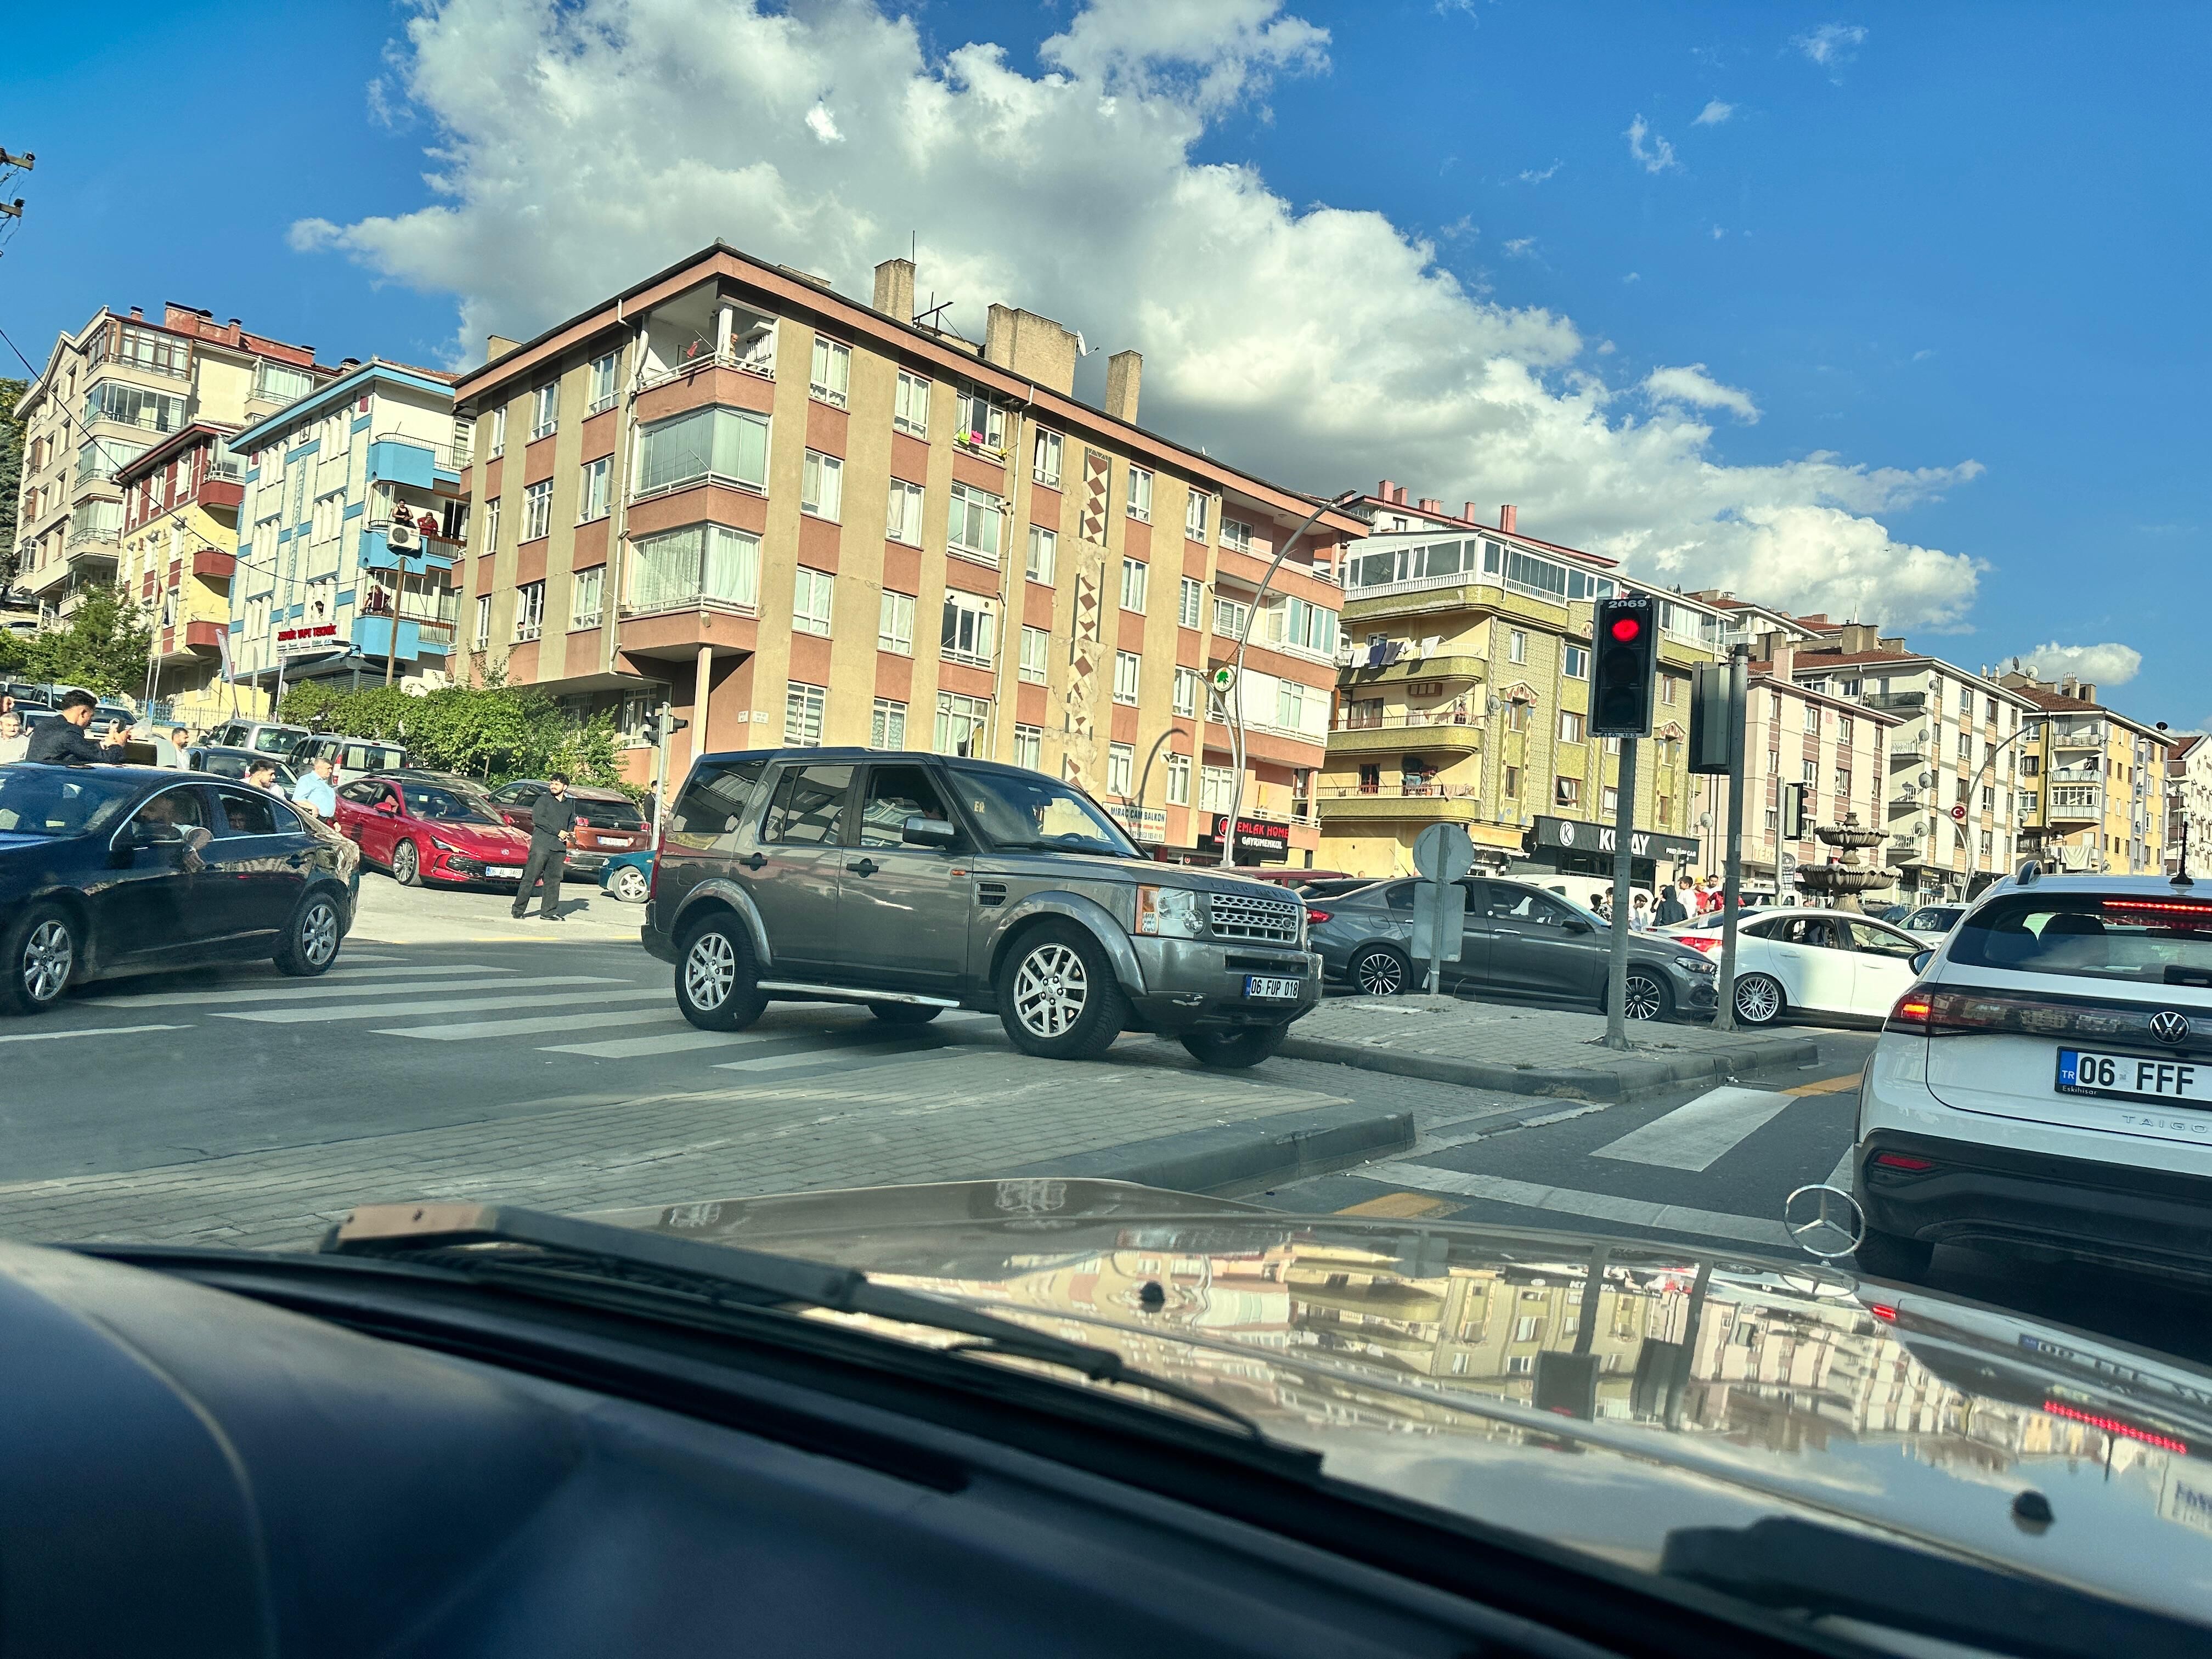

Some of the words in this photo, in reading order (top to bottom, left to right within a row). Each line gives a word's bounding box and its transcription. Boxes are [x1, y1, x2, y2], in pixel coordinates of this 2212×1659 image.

[1608, 599, 1647, 608] 2069
[1110, 806, 1129, 819] MİRAÇ
[1130, 809, 1143, 819] CAM
[1144, 811, 1165, 822] BALKON
[1237, 821, 1265, 836] EMLAK
[1266, 825, 1289, 839] HOME
[1251, 979, 1262, 994] 06
[1266, 980, 1281, 996] FUP
[1284, 981, 1298, 996] 018
[2062, 1070, 2075, 1079] TR
[2079, 1056, 2115, 1086] 06
[2136, 1062, 2195, 1095] FFF
[2062, 1086, 2097, 1095] Eskihisar
[2122, 1115, 2208, 1133] TAIGO
